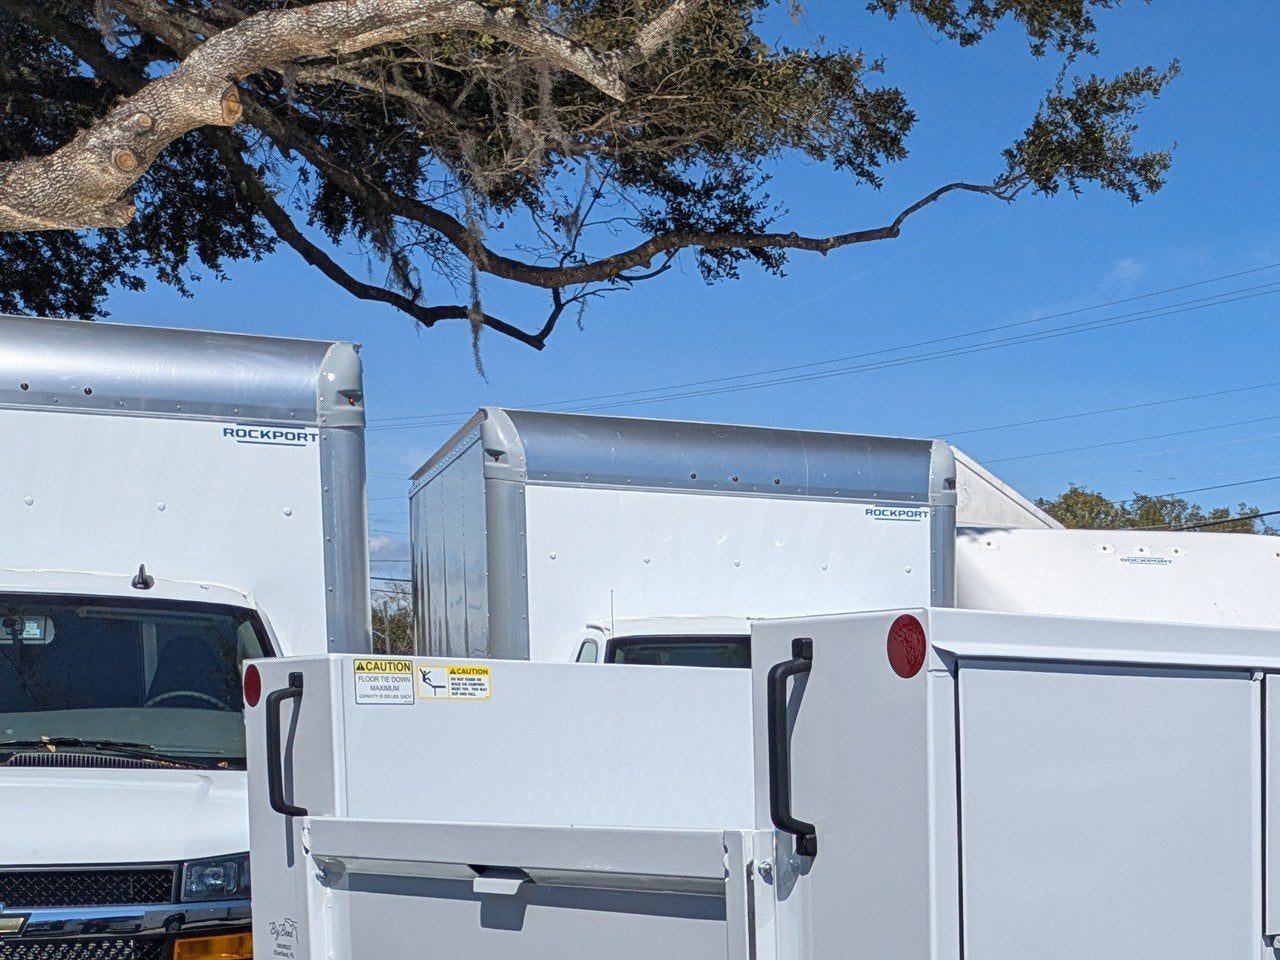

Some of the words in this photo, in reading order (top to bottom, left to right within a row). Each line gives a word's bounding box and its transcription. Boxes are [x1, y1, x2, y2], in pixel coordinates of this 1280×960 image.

[223, 428, 319, 442] ROCKPORT
[865, 508, 929, 518] ROCKPORT
[365, 661, 411, 672] CAUTION
